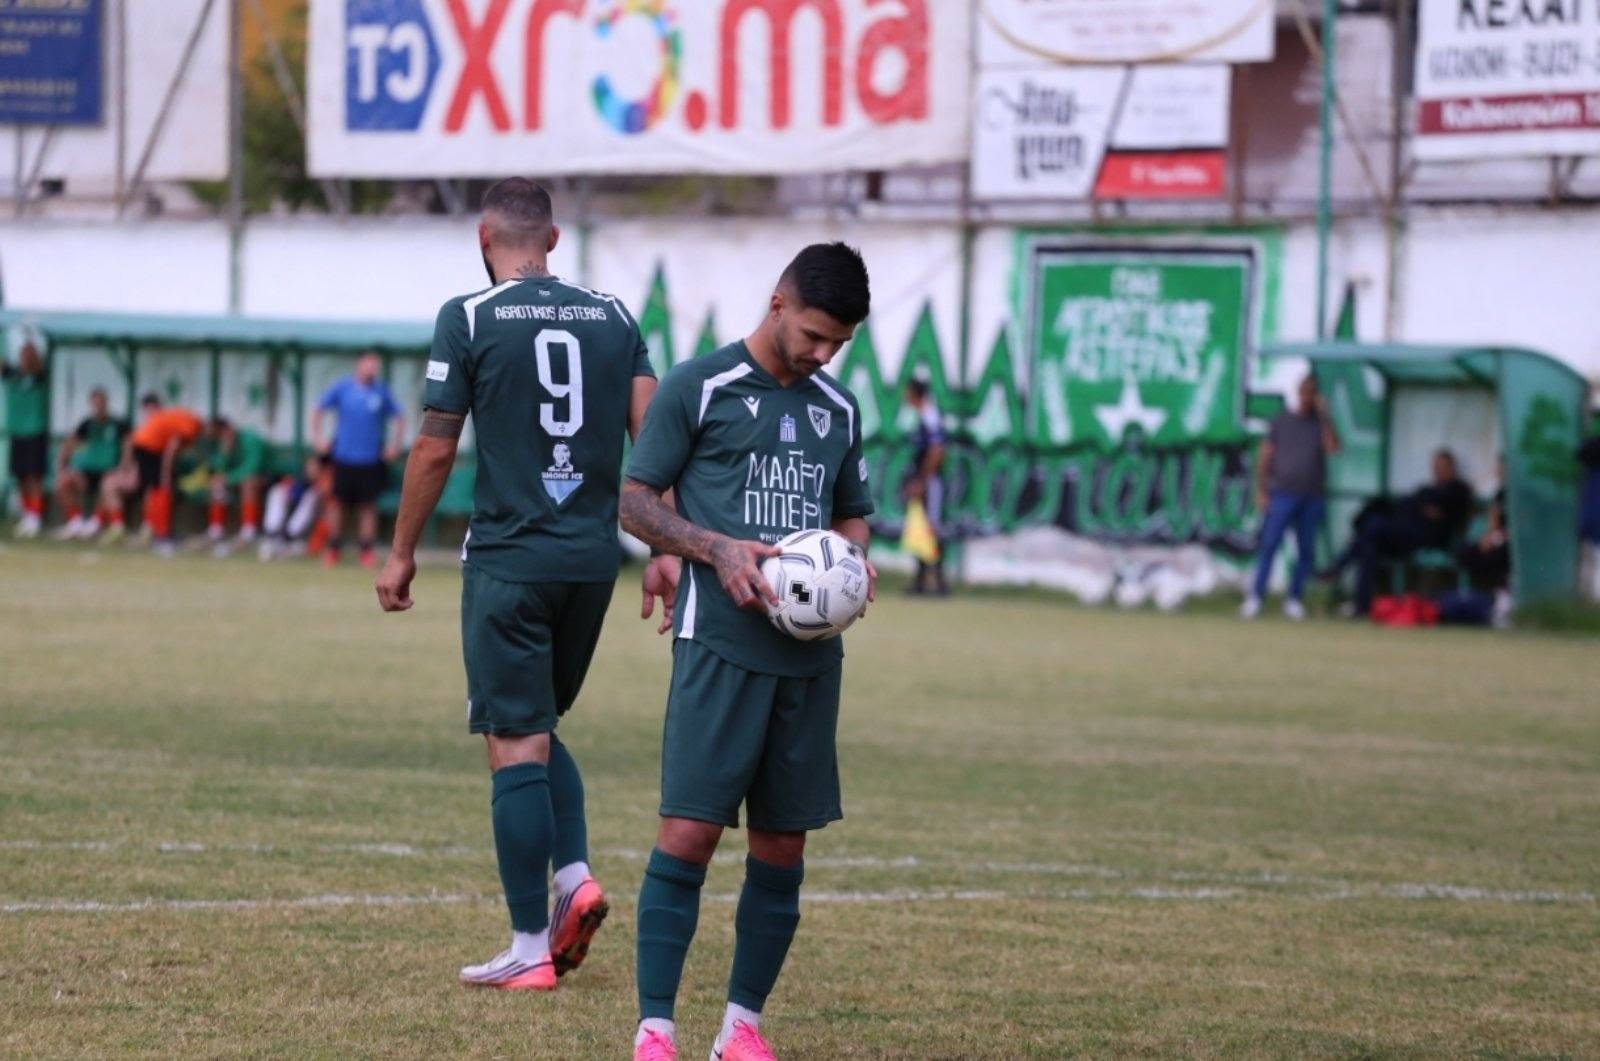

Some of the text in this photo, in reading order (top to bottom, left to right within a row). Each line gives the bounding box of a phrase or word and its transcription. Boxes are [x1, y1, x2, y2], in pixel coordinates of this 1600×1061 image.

[495, 305, 606, 321] AGROTIKOS ASTERAS
[534, 328, 583, 437] 9
